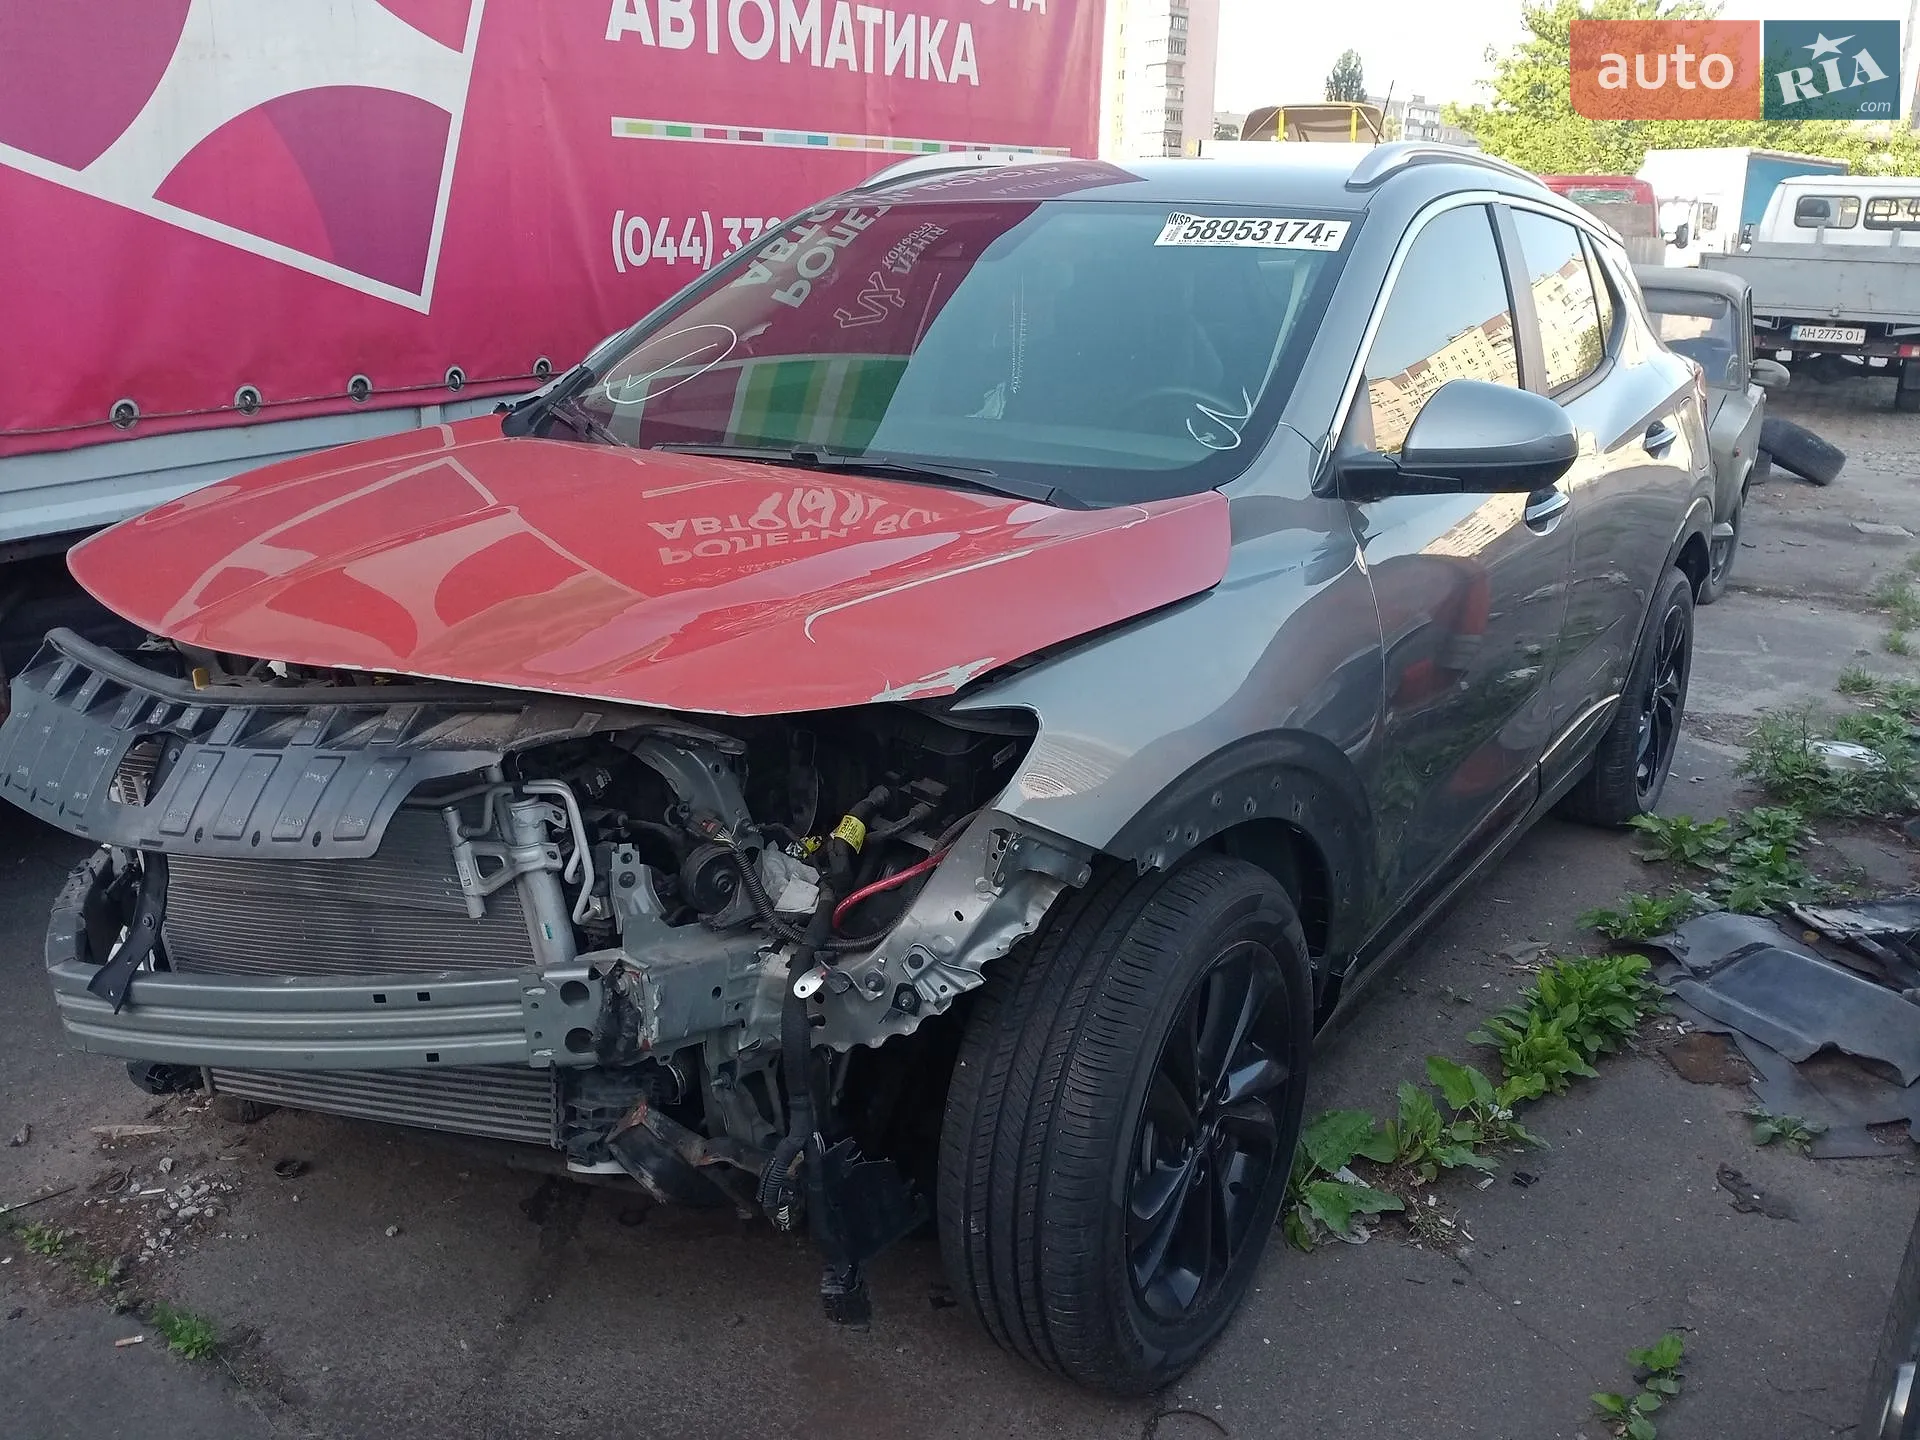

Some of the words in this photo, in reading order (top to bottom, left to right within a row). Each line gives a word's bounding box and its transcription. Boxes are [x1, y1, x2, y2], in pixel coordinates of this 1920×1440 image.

[1168, 212, 1191, 226] INSP
[612, 210, 713, 273] (044)
[1817, 328, 1842, 340] 2775
